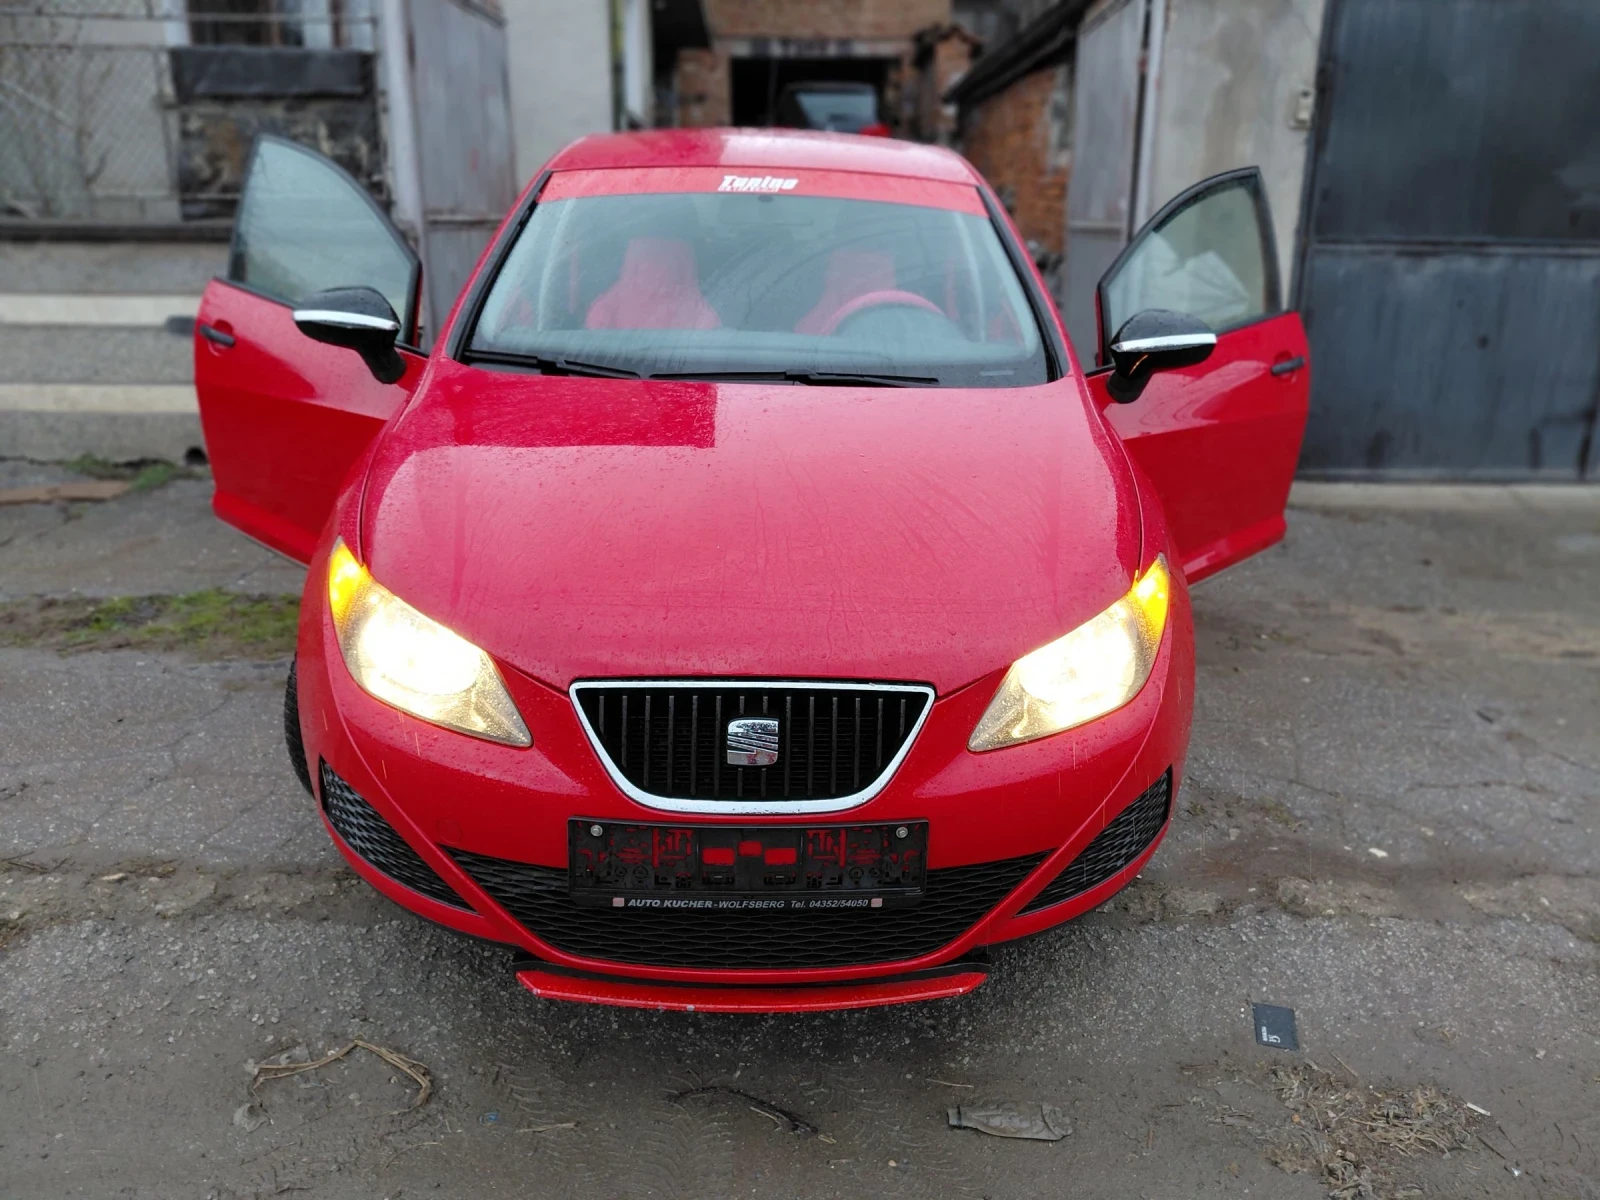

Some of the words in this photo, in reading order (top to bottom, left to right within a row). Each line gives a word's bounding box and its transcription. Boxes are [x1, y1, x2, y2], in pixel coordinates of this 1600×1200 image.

[627, 899, 661, 907] AUTO
[790, 900, 806, 908] Tel.
[808, 899, 869, 908] 04352/54050
